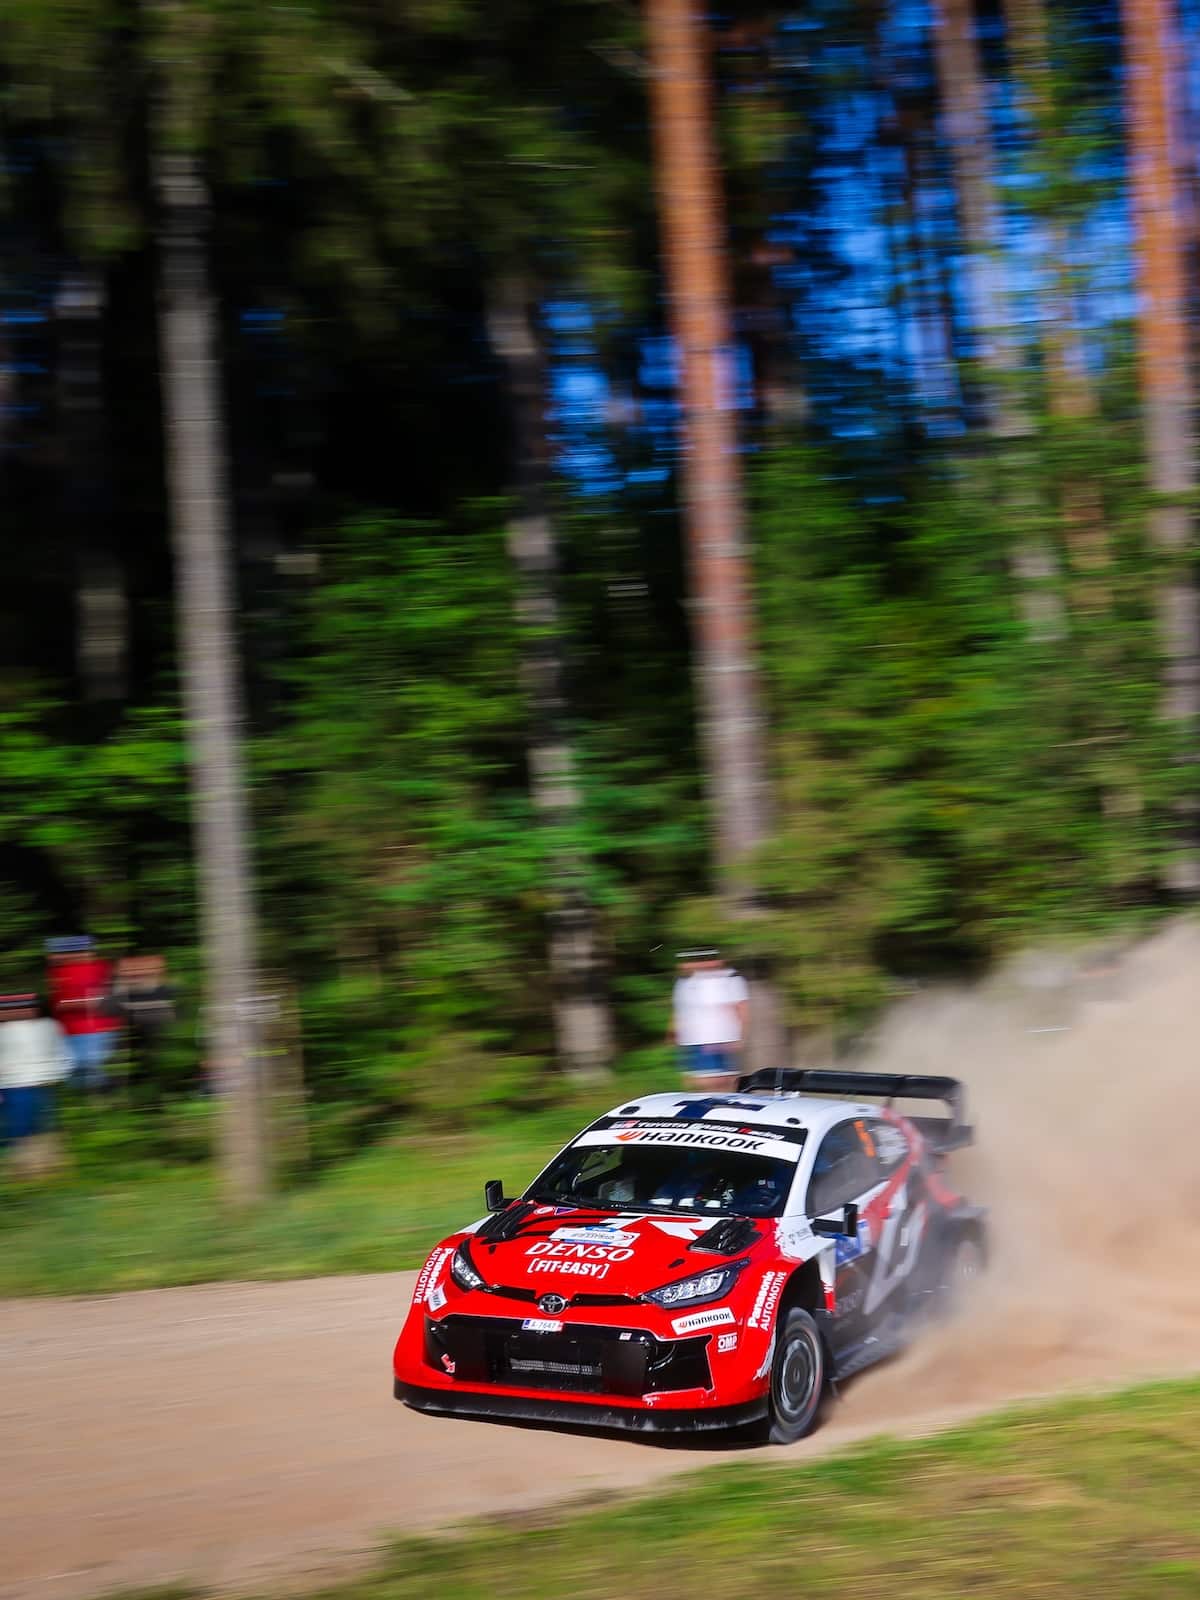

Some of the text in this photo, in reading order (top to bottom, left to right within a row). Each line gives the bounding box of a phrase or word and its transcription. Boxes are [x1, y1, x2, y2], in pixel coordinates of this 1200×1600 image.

[413, 1247, 443, 1304] AUTOMOTIVE
[423, 1247, 455, 1302] Panasonic
[525, 1242, 635, 1261] DENSO
[747, 1271, 776, 1329] Panasonic
[760, 1271, 787, 1331] AUTOMOTIVE
[718, 1335, 737, 1349] OMP
